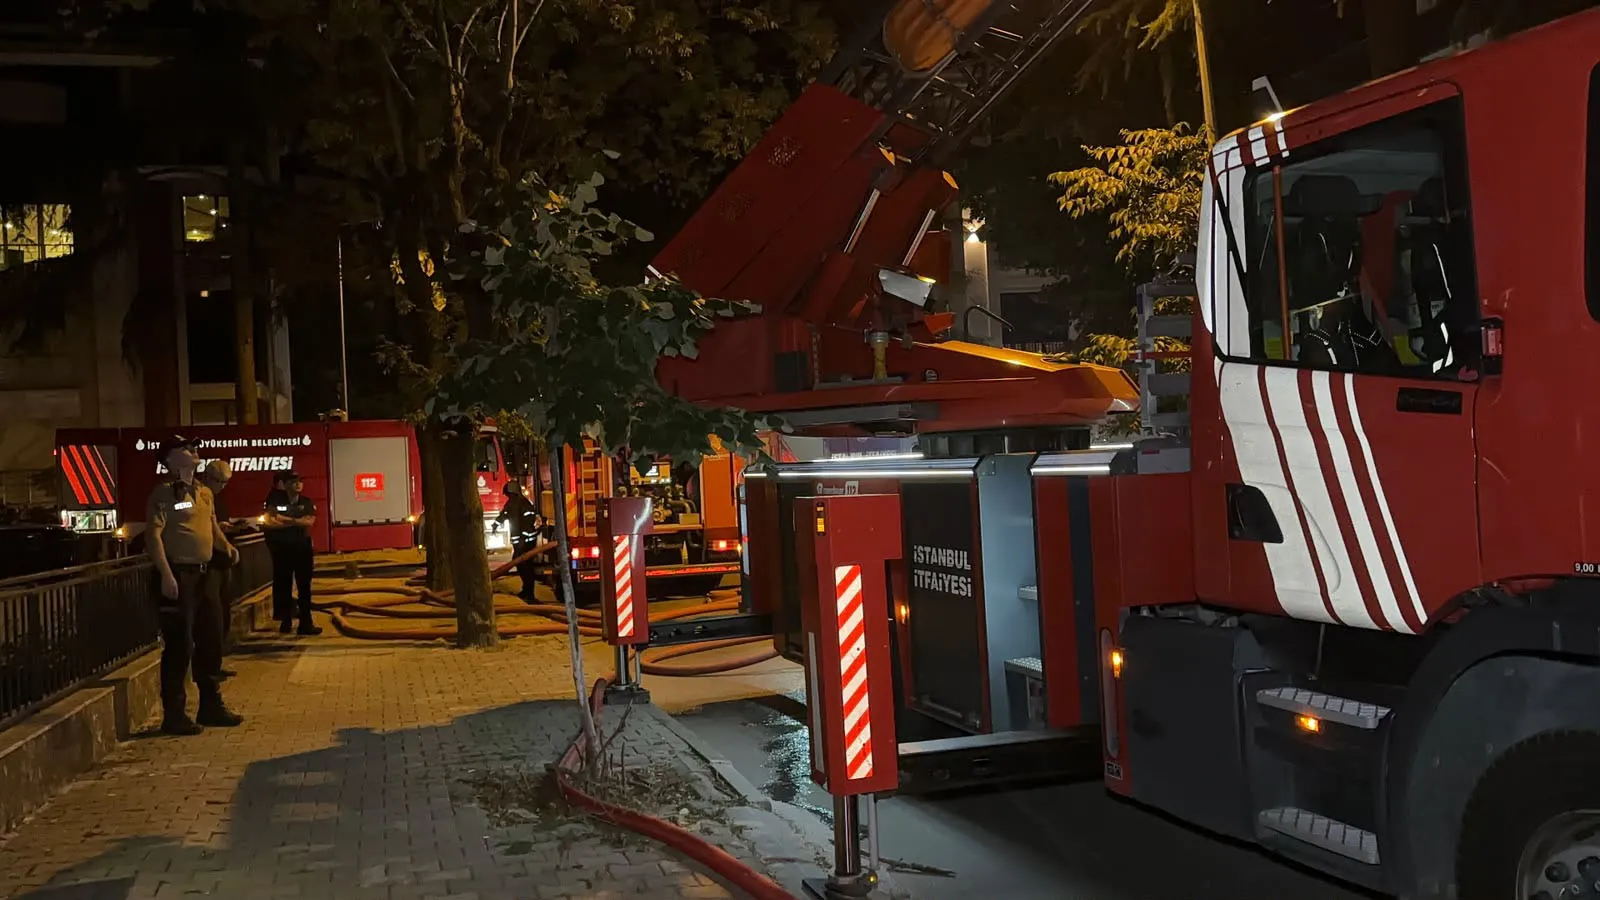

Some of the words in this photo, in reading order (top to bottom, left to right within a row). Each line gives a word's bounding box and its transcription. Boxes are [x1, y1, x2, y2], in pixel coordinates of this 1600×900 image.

[251, 437, 300, 447] BELEDİYESİ
[229, 456, 294, 472] İTFAİYESİ
[361, 477, 377, 488] 112
[913, 545, 972, 570] İSTANBUL
[1575, 562, 1594, 573] 9,00
[913, 569, 972, 597] İTFAİYESİ
